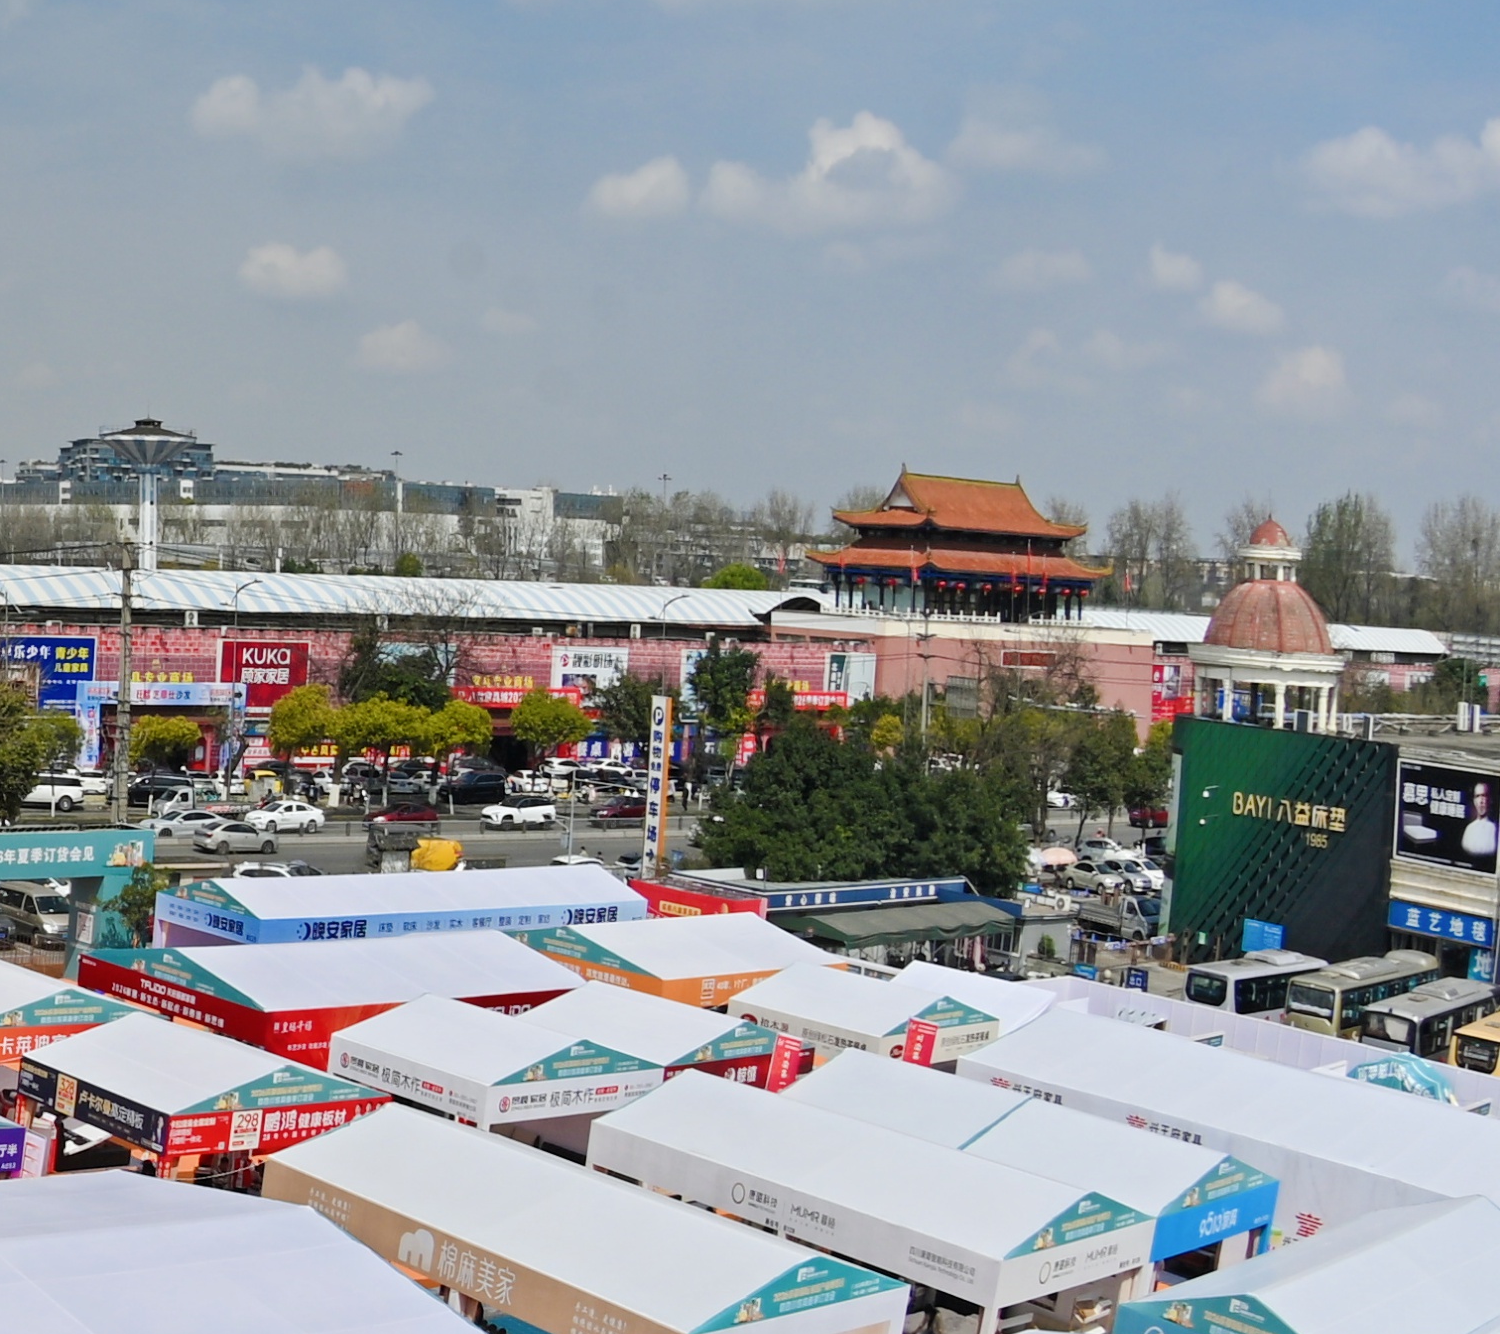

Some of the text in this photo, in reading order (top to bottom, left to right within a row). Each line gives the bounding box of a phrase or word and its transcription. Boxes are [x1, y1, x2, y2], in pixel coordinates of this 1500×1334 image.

[1232, 791, 1347, 833] BAYI 八益床垫
[436, 1238, 517, 1307] 棉麻美家
